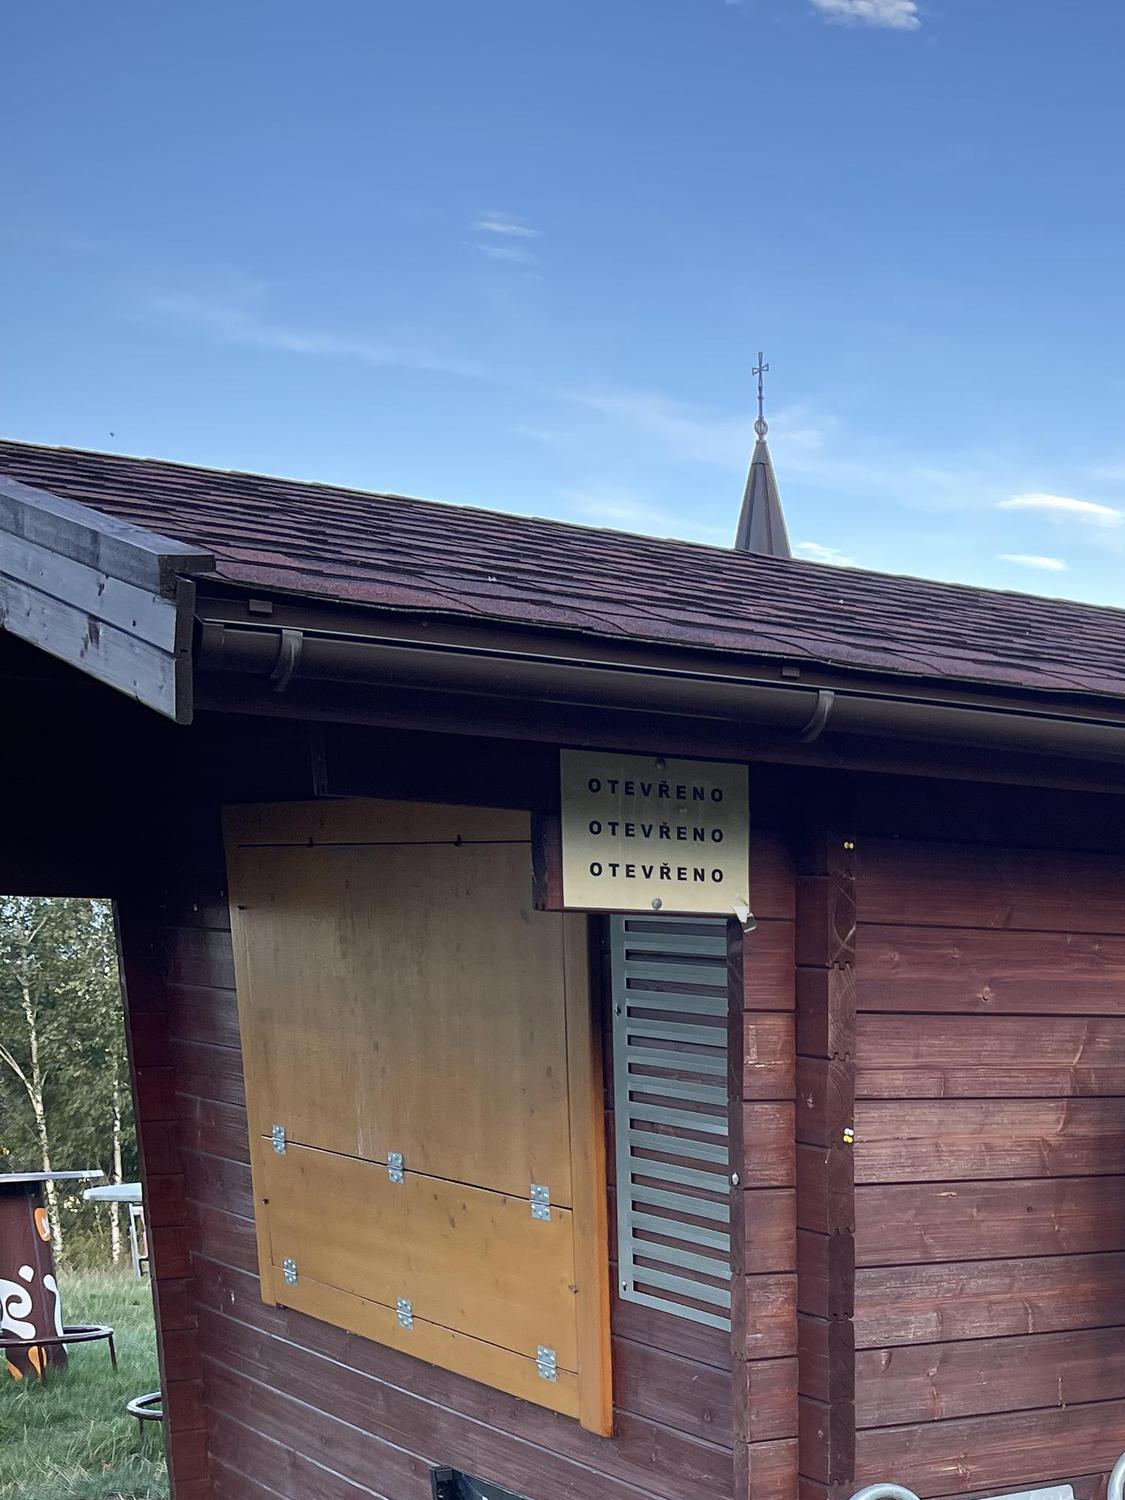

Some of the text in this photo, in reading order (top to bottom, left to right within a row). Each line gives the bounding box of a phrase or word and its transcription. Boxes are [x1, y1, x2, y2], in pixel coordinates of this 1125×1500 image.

[588, 778, 723, 802] OTEVŘENO
[589, 820, 723, 842] OTEVŘENO
[589, 862, 723, 882] OTEVŘENO
